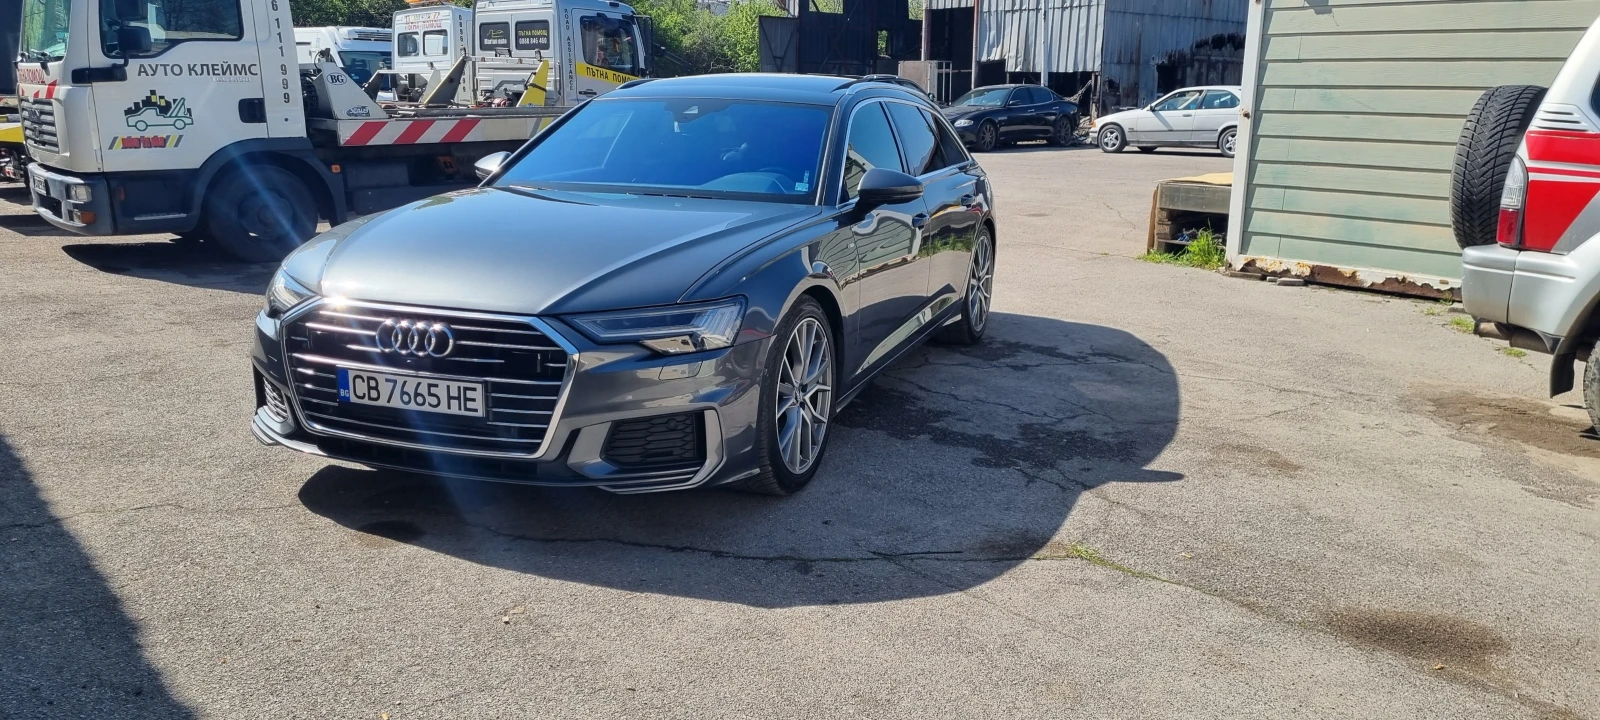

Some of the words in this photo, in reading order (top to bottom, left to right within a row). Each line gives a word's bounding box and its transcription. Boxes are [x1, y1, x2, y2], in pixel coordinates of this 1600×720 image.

[137, 63, 184, 76] АУТО
[187, 61, 258, 76] КЛЕЙМС
[586, 66, 609, 80] ПЪТНА
[280, 63, 290, 104] 999
[330, 74, 344, 84] BG
[340, 389, 350, 398] BG
[384, 378, 441, 409] 7665
